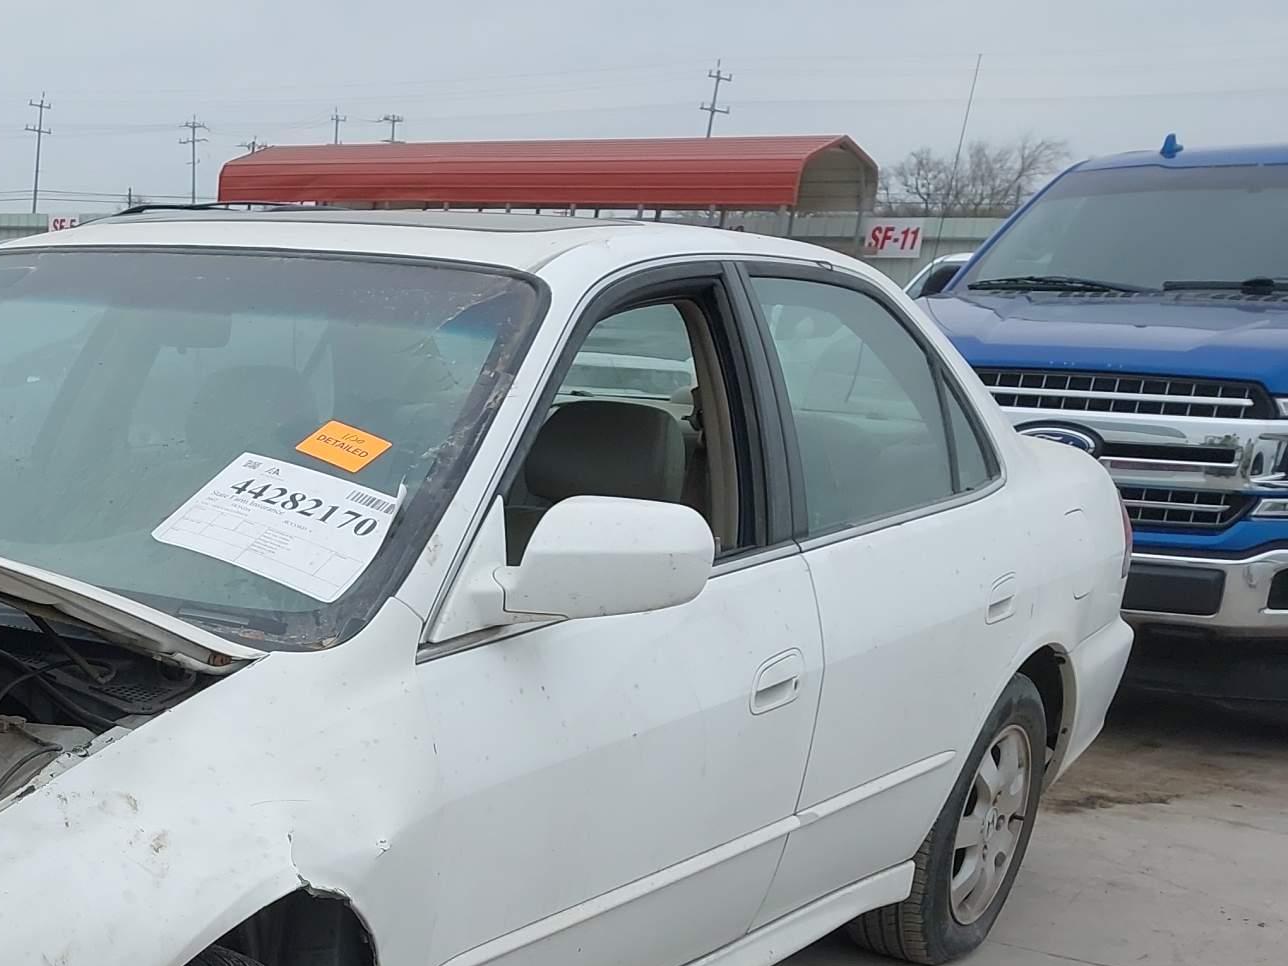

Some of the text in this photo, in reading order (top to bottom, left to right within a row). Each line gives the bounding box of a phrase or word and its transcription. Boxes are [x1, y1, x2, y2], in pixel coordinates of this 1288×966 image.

[867, 226, 921, 250] SF-11
[316, 434, 369, 458] DETAILED
[230, 478, 379, 537] 44282170
